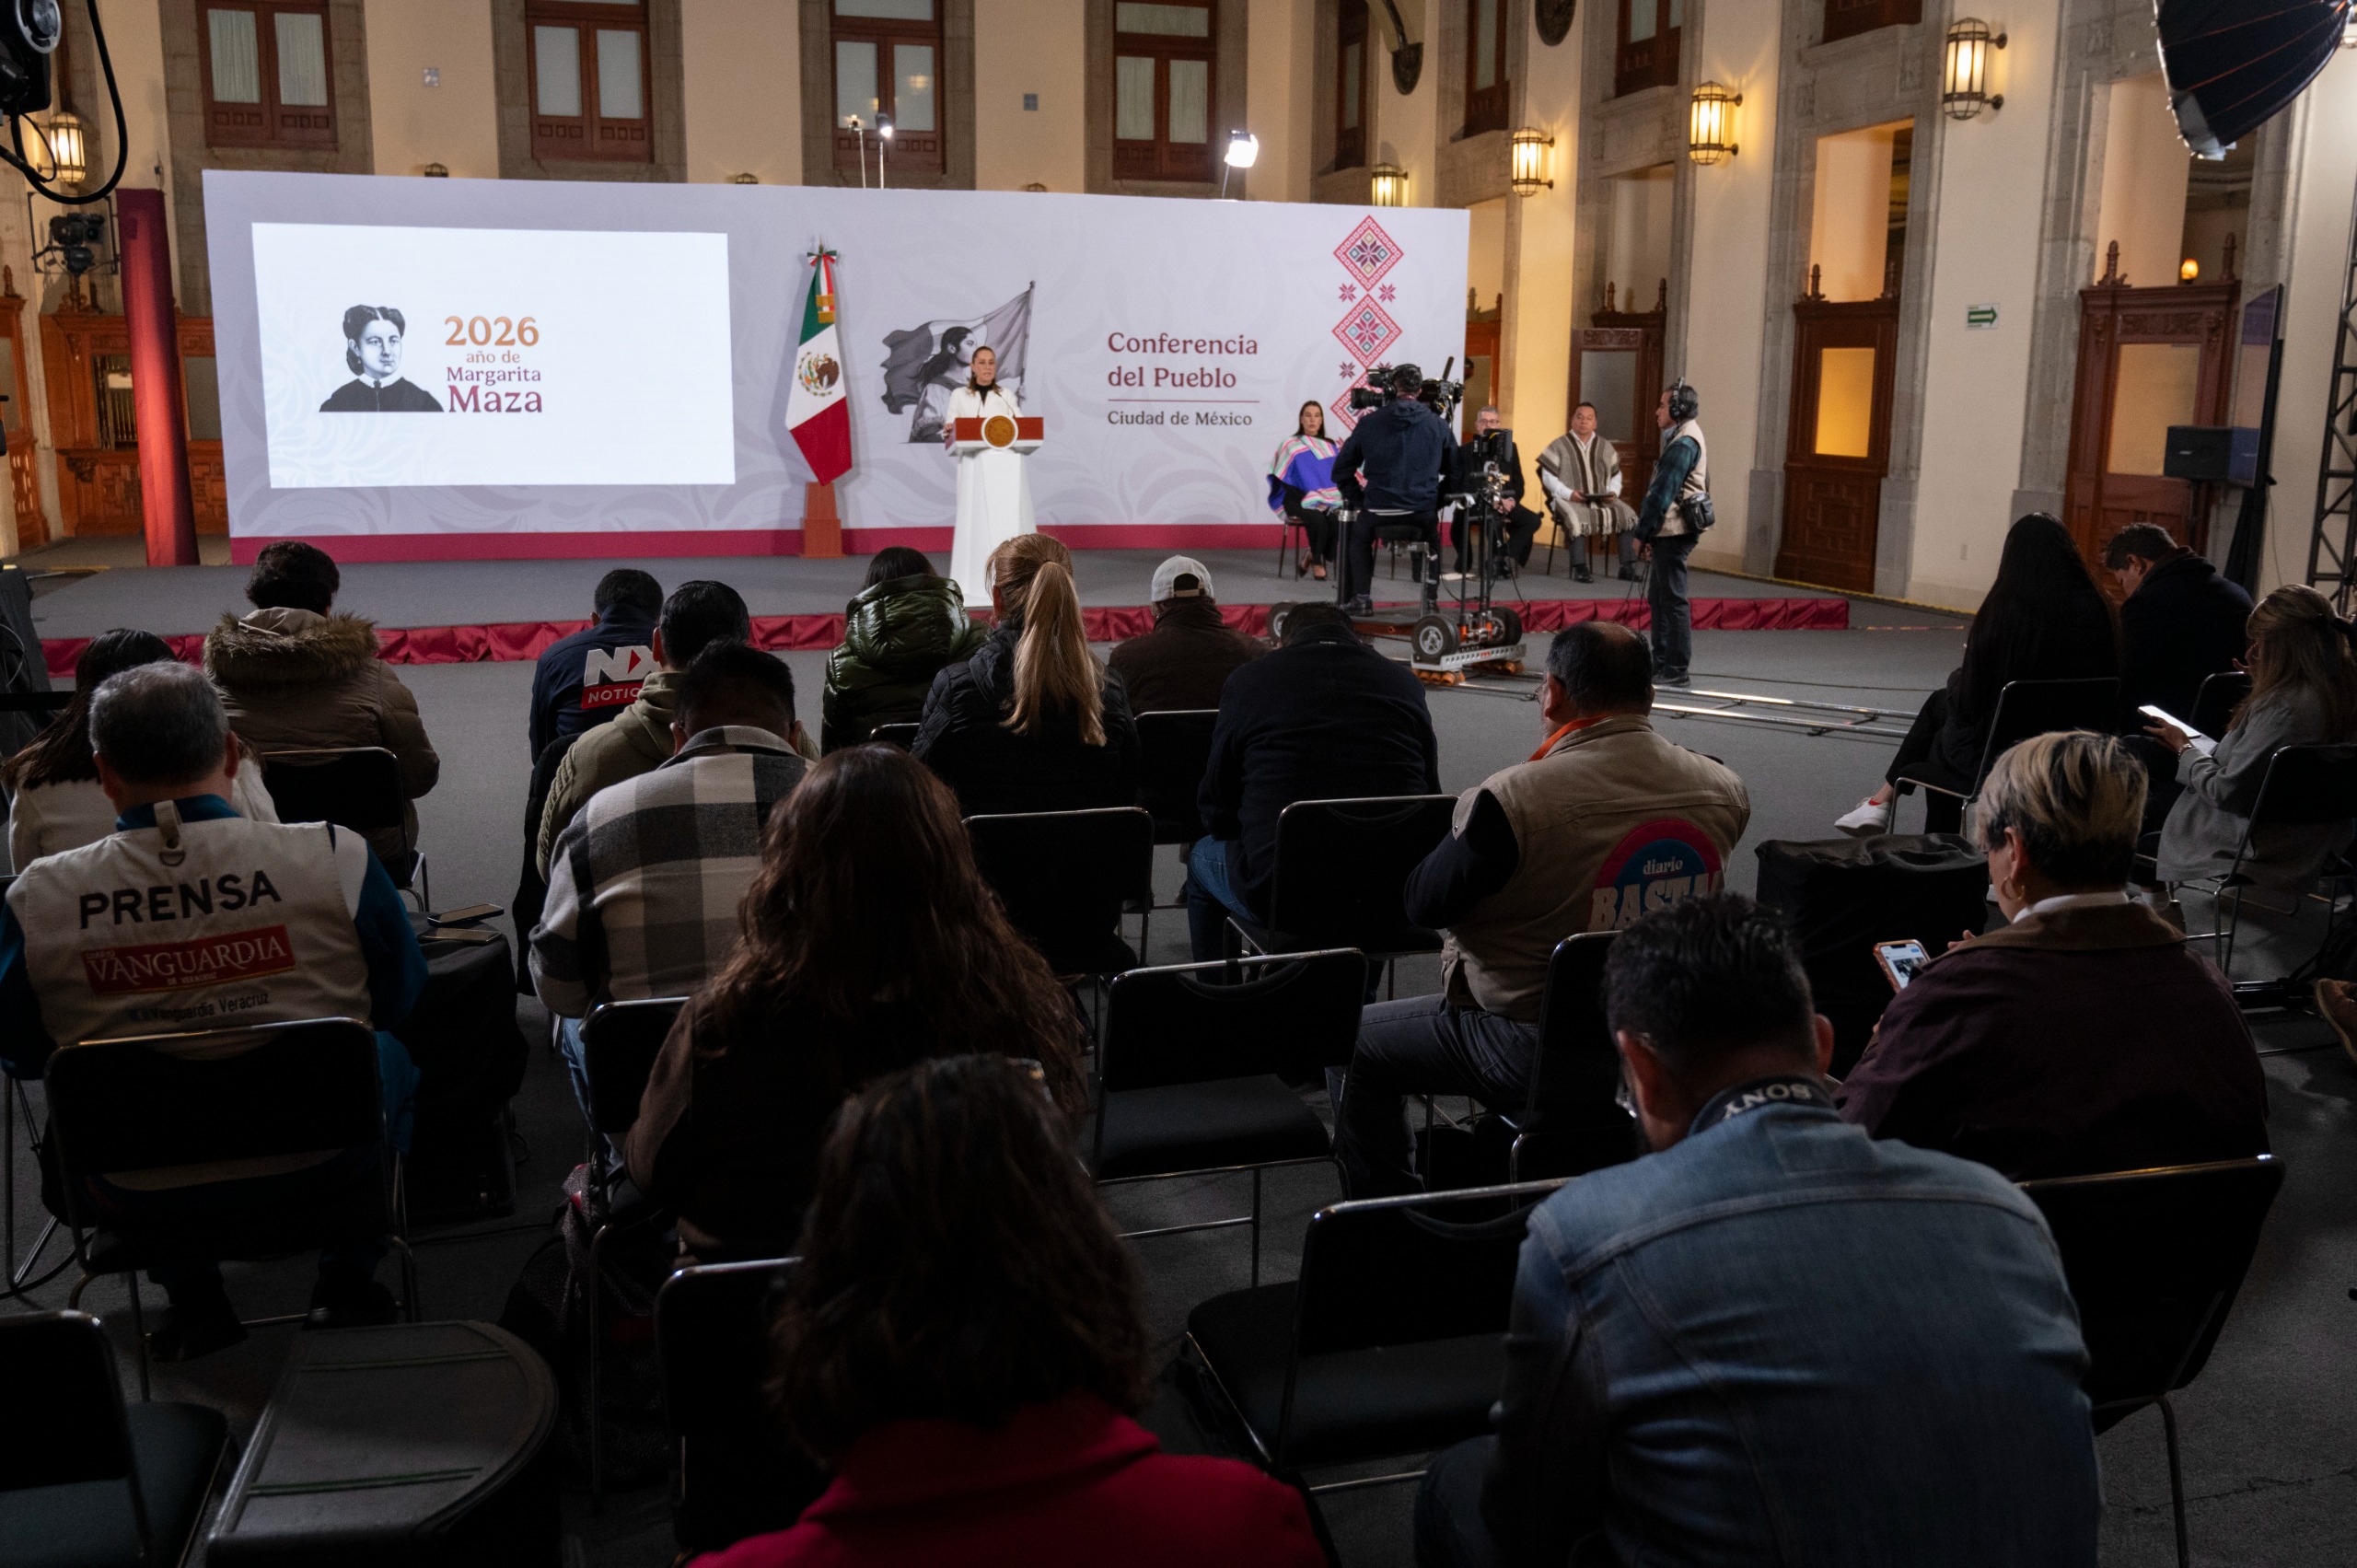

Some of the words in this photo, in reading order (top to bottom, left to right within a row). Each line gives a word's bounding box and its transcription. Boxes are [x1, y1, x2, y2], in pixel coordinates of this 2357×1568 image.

[444, 315, 540, 347] 2026
[1108, 331, 1259, 355] Conferencia
[466, 350, 496, 364] año
[501, 349, 521, 364] de
[447, 366, 541, 387] Margarita
[1108, 366, 1144, 388] del
[1154, 366, 1237, 388] Pueblo
[448, 385, 543, 413] Maza
[1108, 411, 1165, 425] Ciudad
[1170, 412, 1190, 425] de
[1195, 412, 1252, 426] México
[1643, 855, 1684, 875] diario
[79, 869, 282, 930] PRENSA
[87, 935, 287, 985] VANGUARDIA
[150, 1002, 215, 1022] Vanguardia
[218, 993, 269, 1013] Veracruz
[1723, 1083, 1813, 1121] SONY
